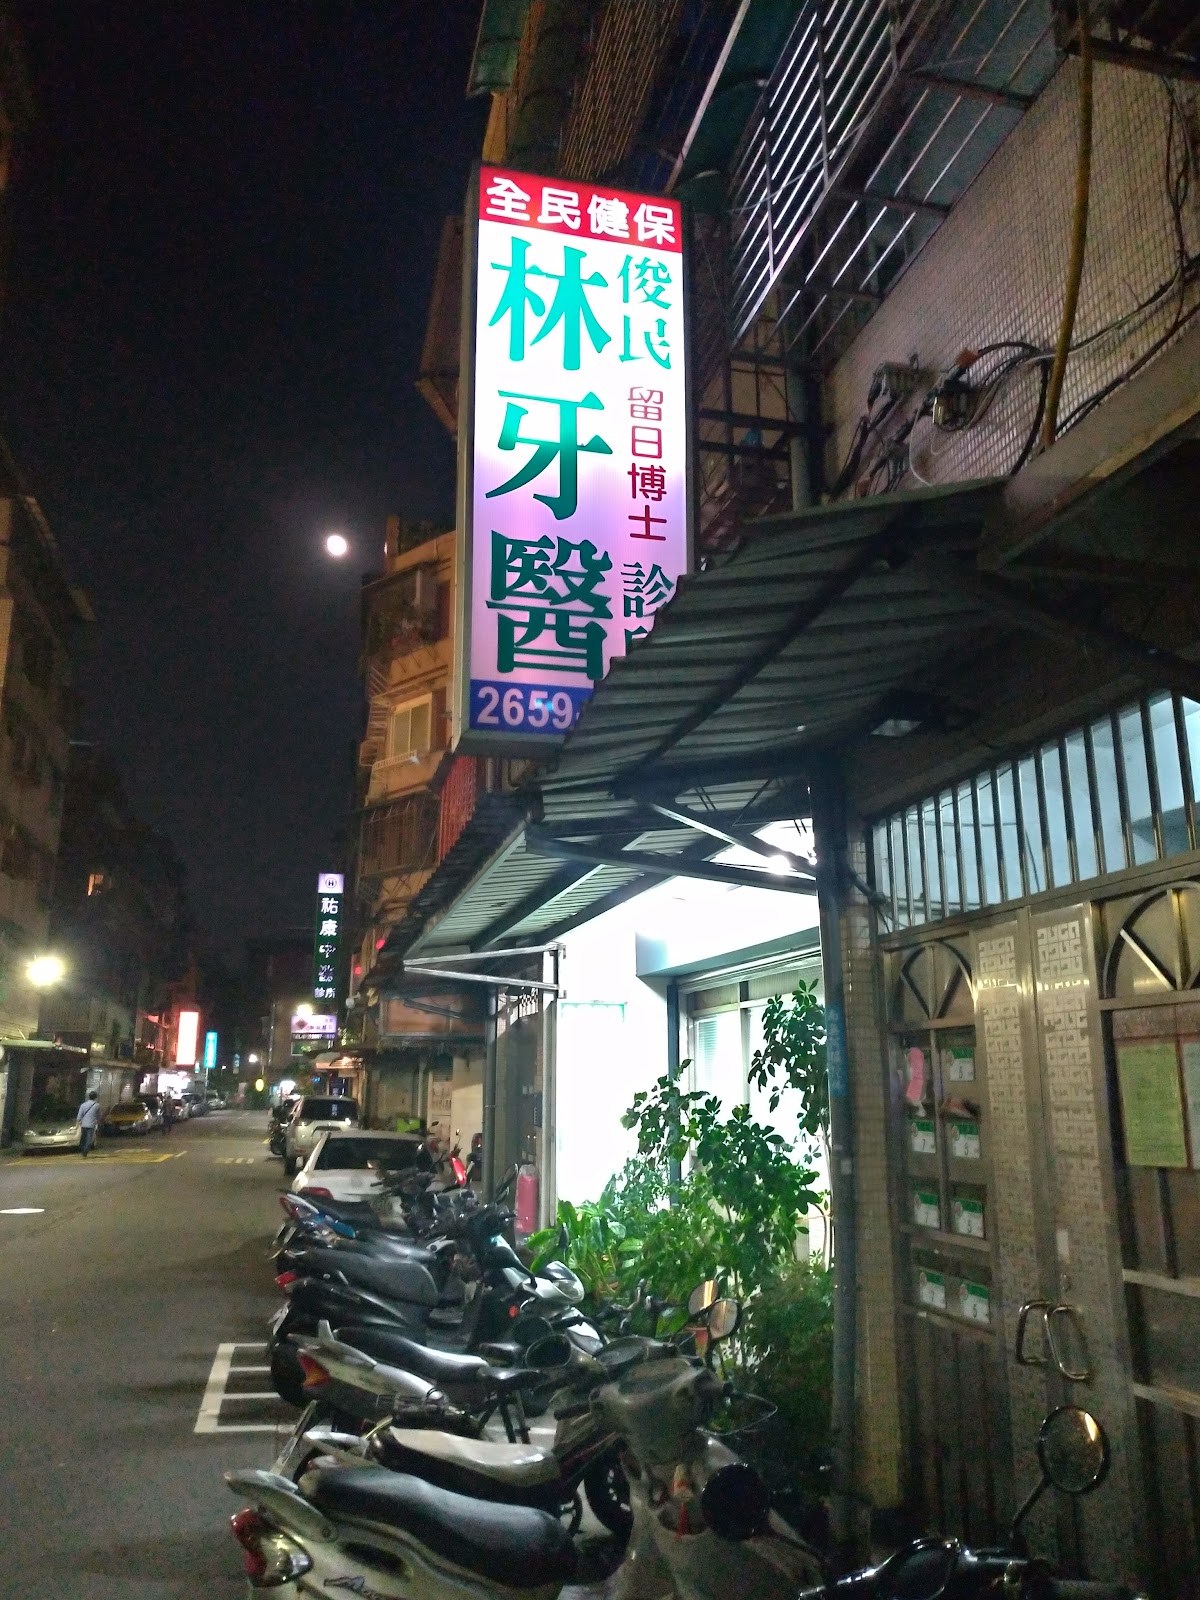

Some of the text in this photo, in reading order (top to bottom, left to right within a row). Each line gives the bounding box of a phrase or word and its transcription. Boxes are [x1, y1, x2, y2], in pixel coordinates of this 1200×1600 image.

[486, 177, 676, 245] 全民健保
[617, 254, 673, 370] 俊民
[485, 236, 614, 681] 林牙醫
[627, 386, 668, 541] 留日博士
[620, 562, 675, 652] 診
